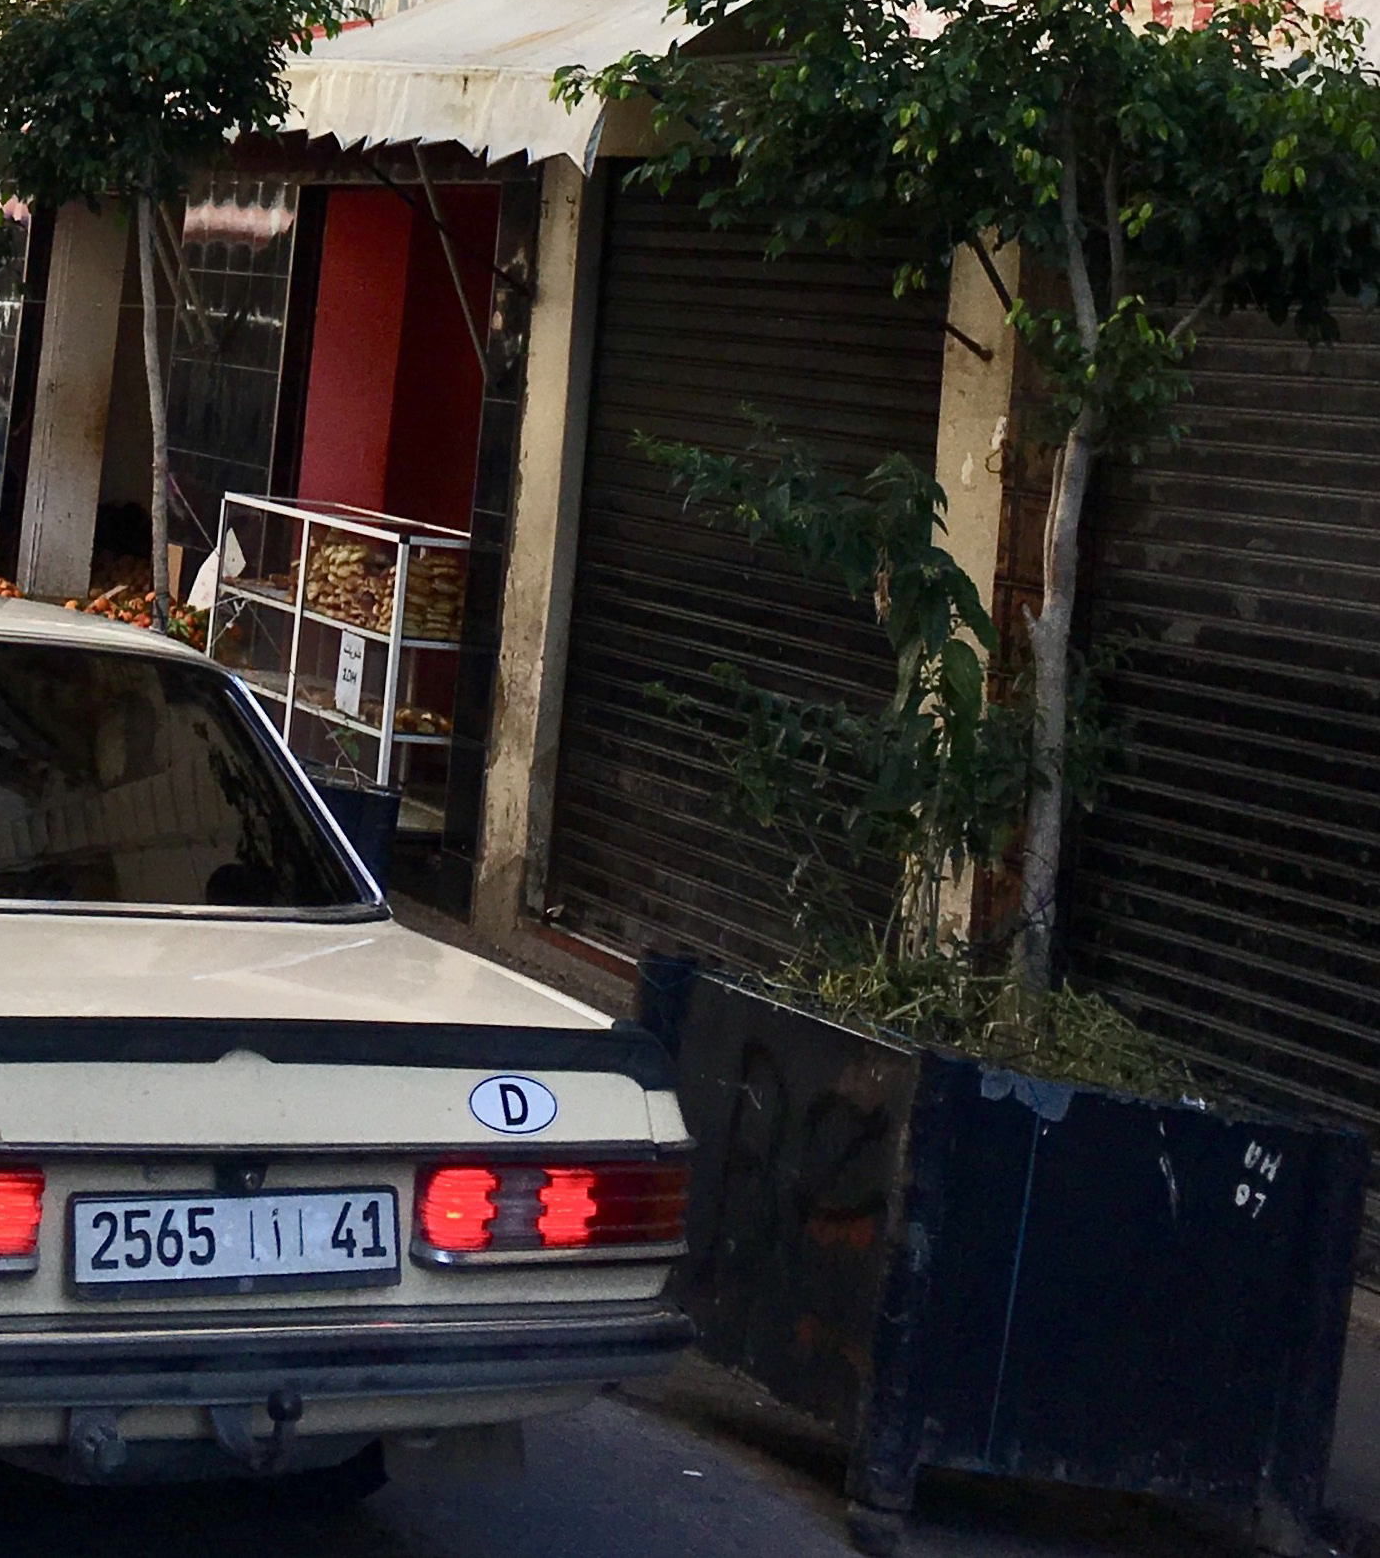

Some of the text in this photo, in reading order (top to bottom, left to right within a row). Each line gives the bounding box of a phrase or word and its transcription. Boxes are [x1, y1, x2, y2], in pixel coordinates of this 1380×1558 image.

[499, 1083, 528, 1126] D
[91, 1206, 216, 1271] 2565
[331, 1200, 387, 1259] 41
